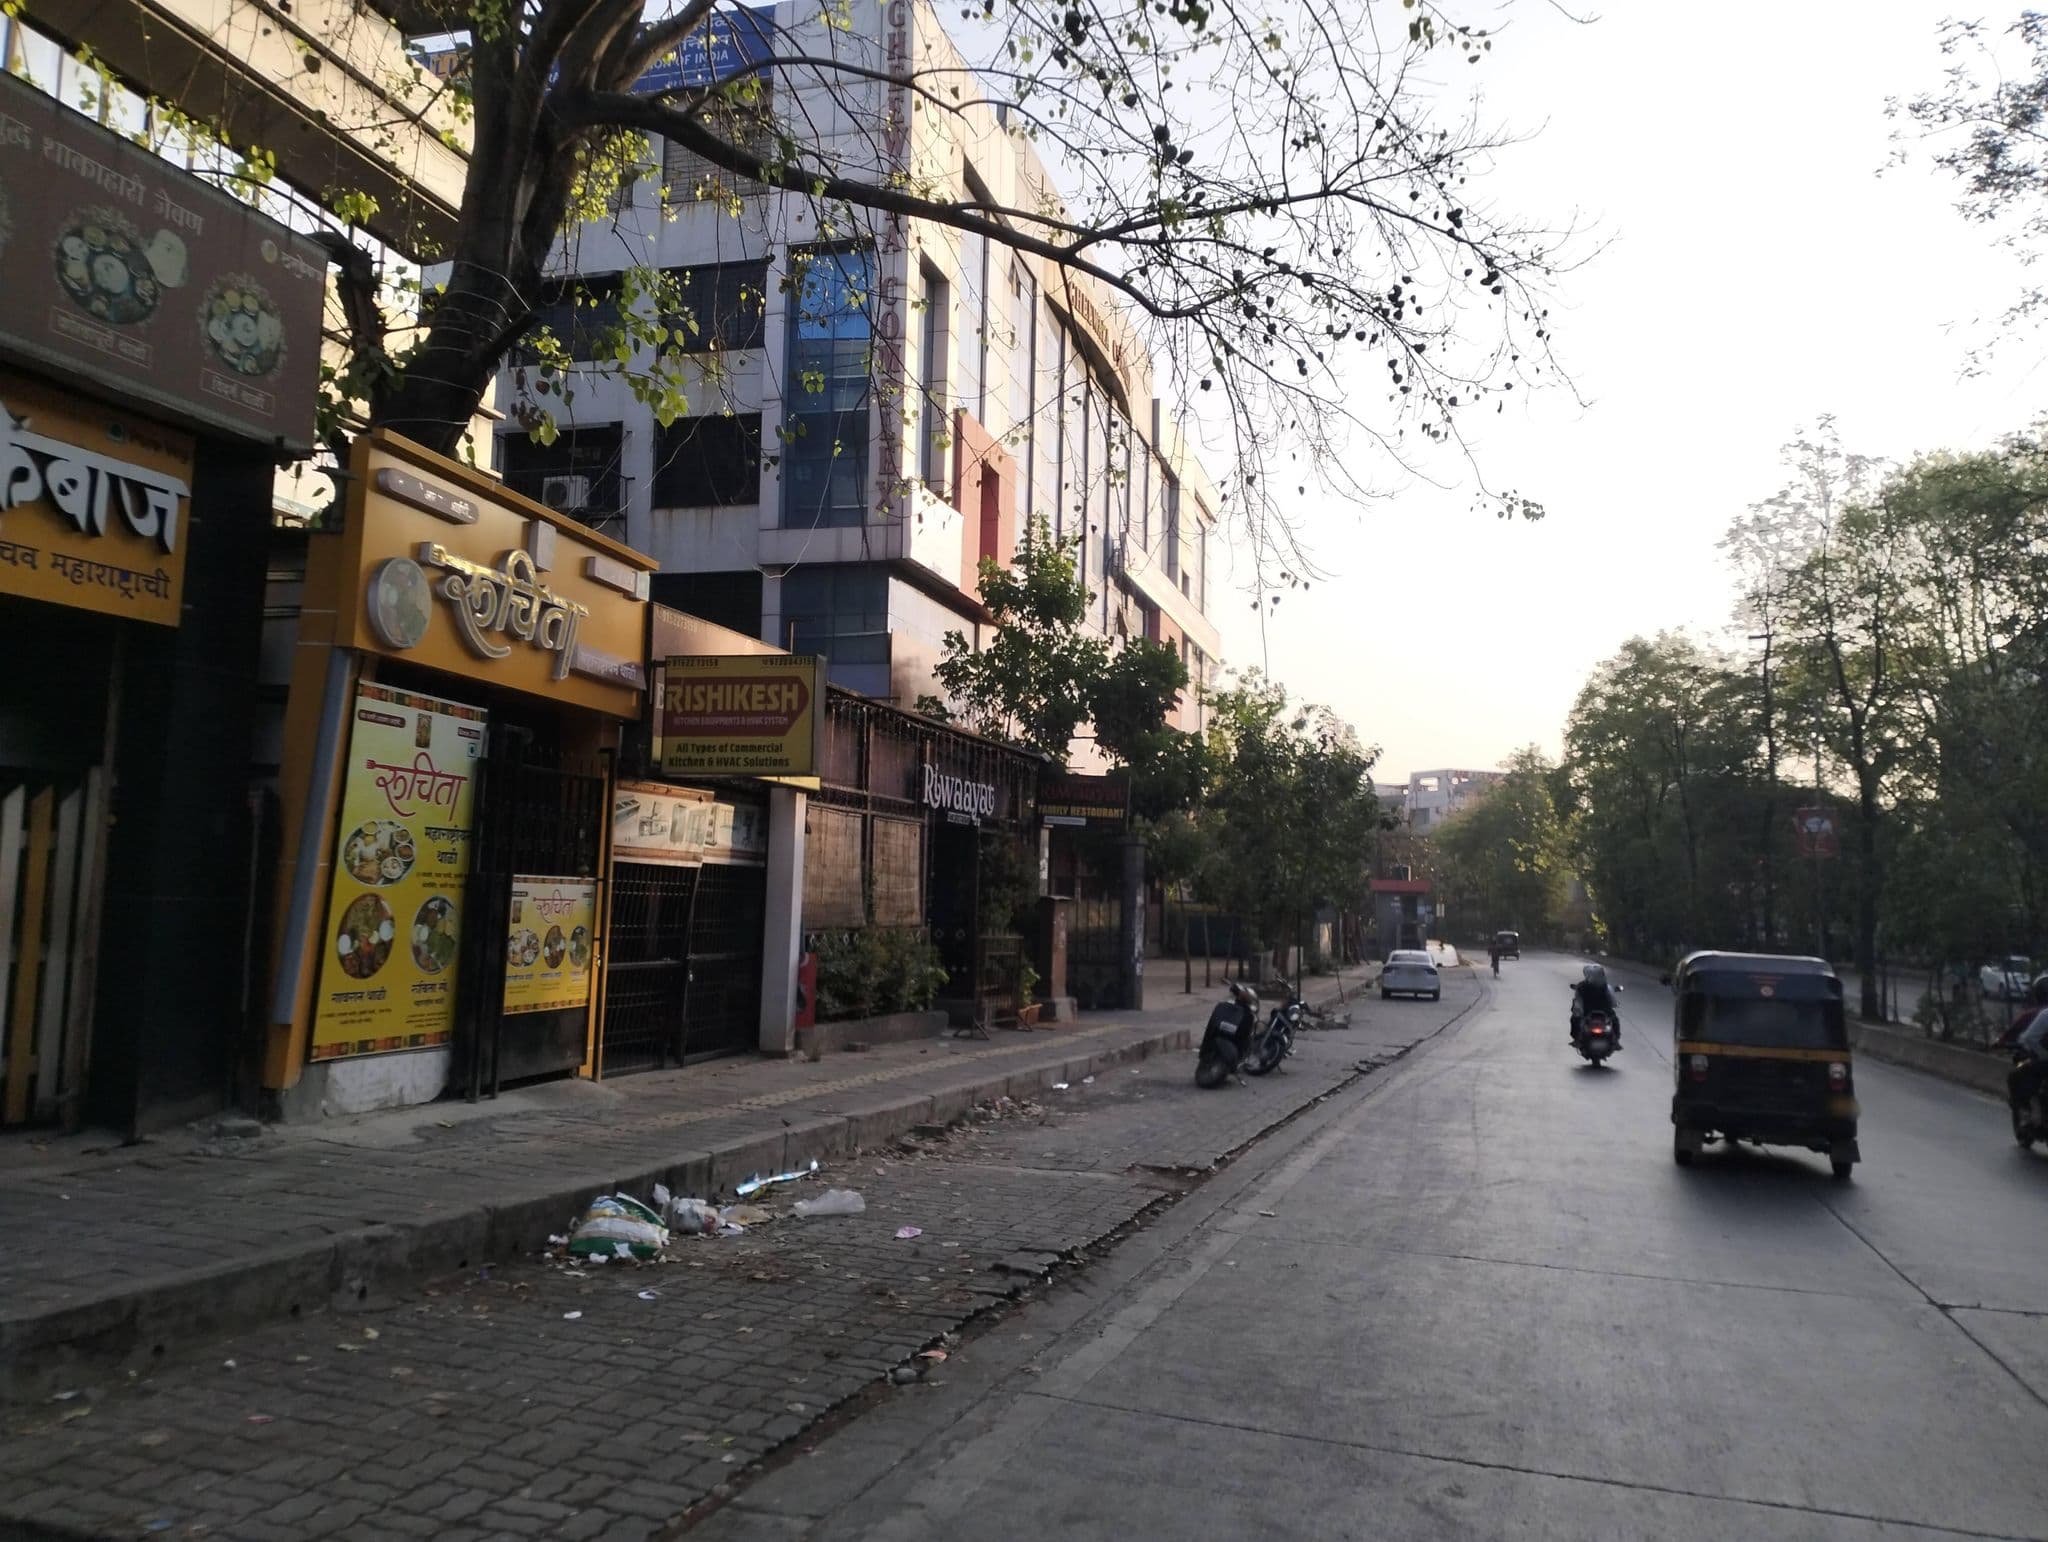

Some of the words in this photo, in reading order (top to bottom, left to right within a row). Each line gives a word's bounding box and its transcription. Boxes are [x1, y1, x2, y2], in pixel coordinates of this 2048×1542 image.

[695, 50, 728, 63] INDIA
[665, 680, 799, 714] RISHIKESH
[677, 743, 690, 753] All
[691, 743, 717, 755] Types
[718, 743, 728, 753] of
[730, 743, 783, 753] Commercial
[669, 756, 705, 767] Kitchen
[716, 756, 741, 767] HVAC
[744, 756, 789, 767] Solutions
[923, 763, 995, 817] Riwaayat
